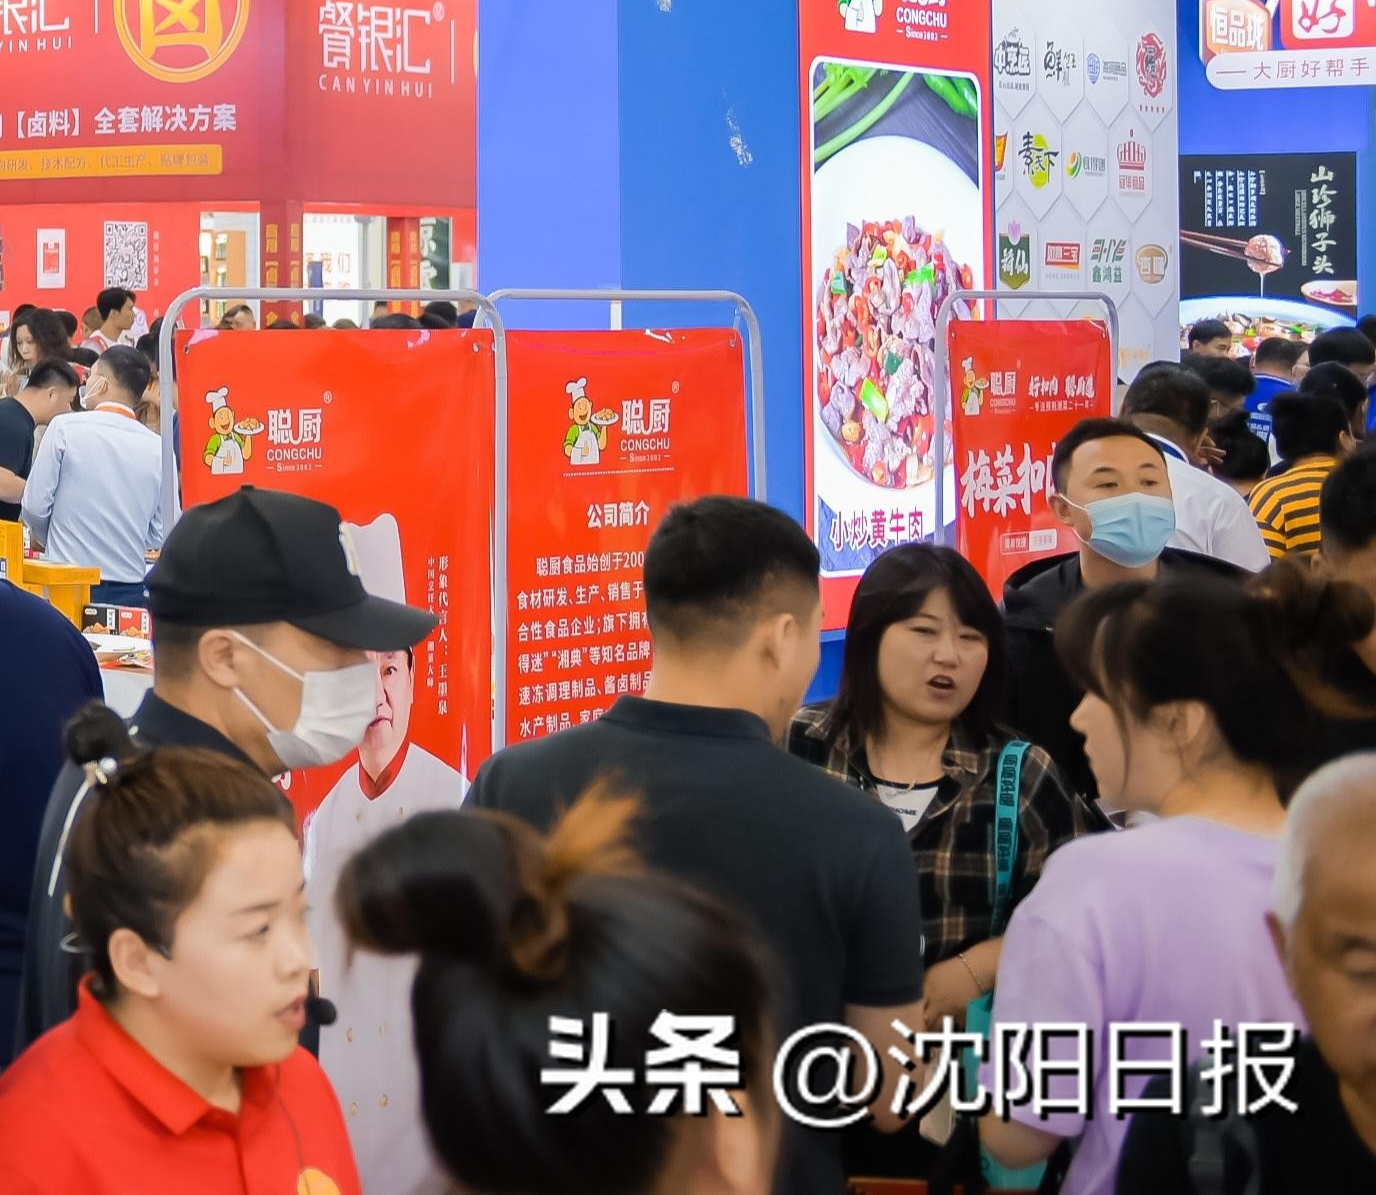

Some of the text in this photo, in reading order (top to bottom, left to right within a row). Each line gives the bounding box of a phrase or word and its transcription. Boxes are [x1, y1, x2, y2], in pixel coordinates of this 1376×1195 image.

[896, 7, 947, 28] CONGCHU
[1253, 57, 1370, 80] 大厨好帮手
[1018, 130, 1060, 183] 素天下
[1308, 165, 1338, 275] 山珍狮子头
[1092, 264, 1123, 284] 鑫鸿益
[990, 371, 1016, 396] 聪厨
[267, 408, 323, 445] 聪厨
[621, 398, 672, 436] 聪厨
[266, 449, 322, 462] CONGCHU
[620, 438, 671, 452] CONGCHU
[960, 442, 1056, 518] 梅菜扣
[586, 500, 651, 529] 公司简介
[830, 509, 924, 552] 小炒黄牛肉
[536, 551, 645, 577] 聪厨食品始创于200
[517, 580, 644, 611] 食材研发、生产、销售于
